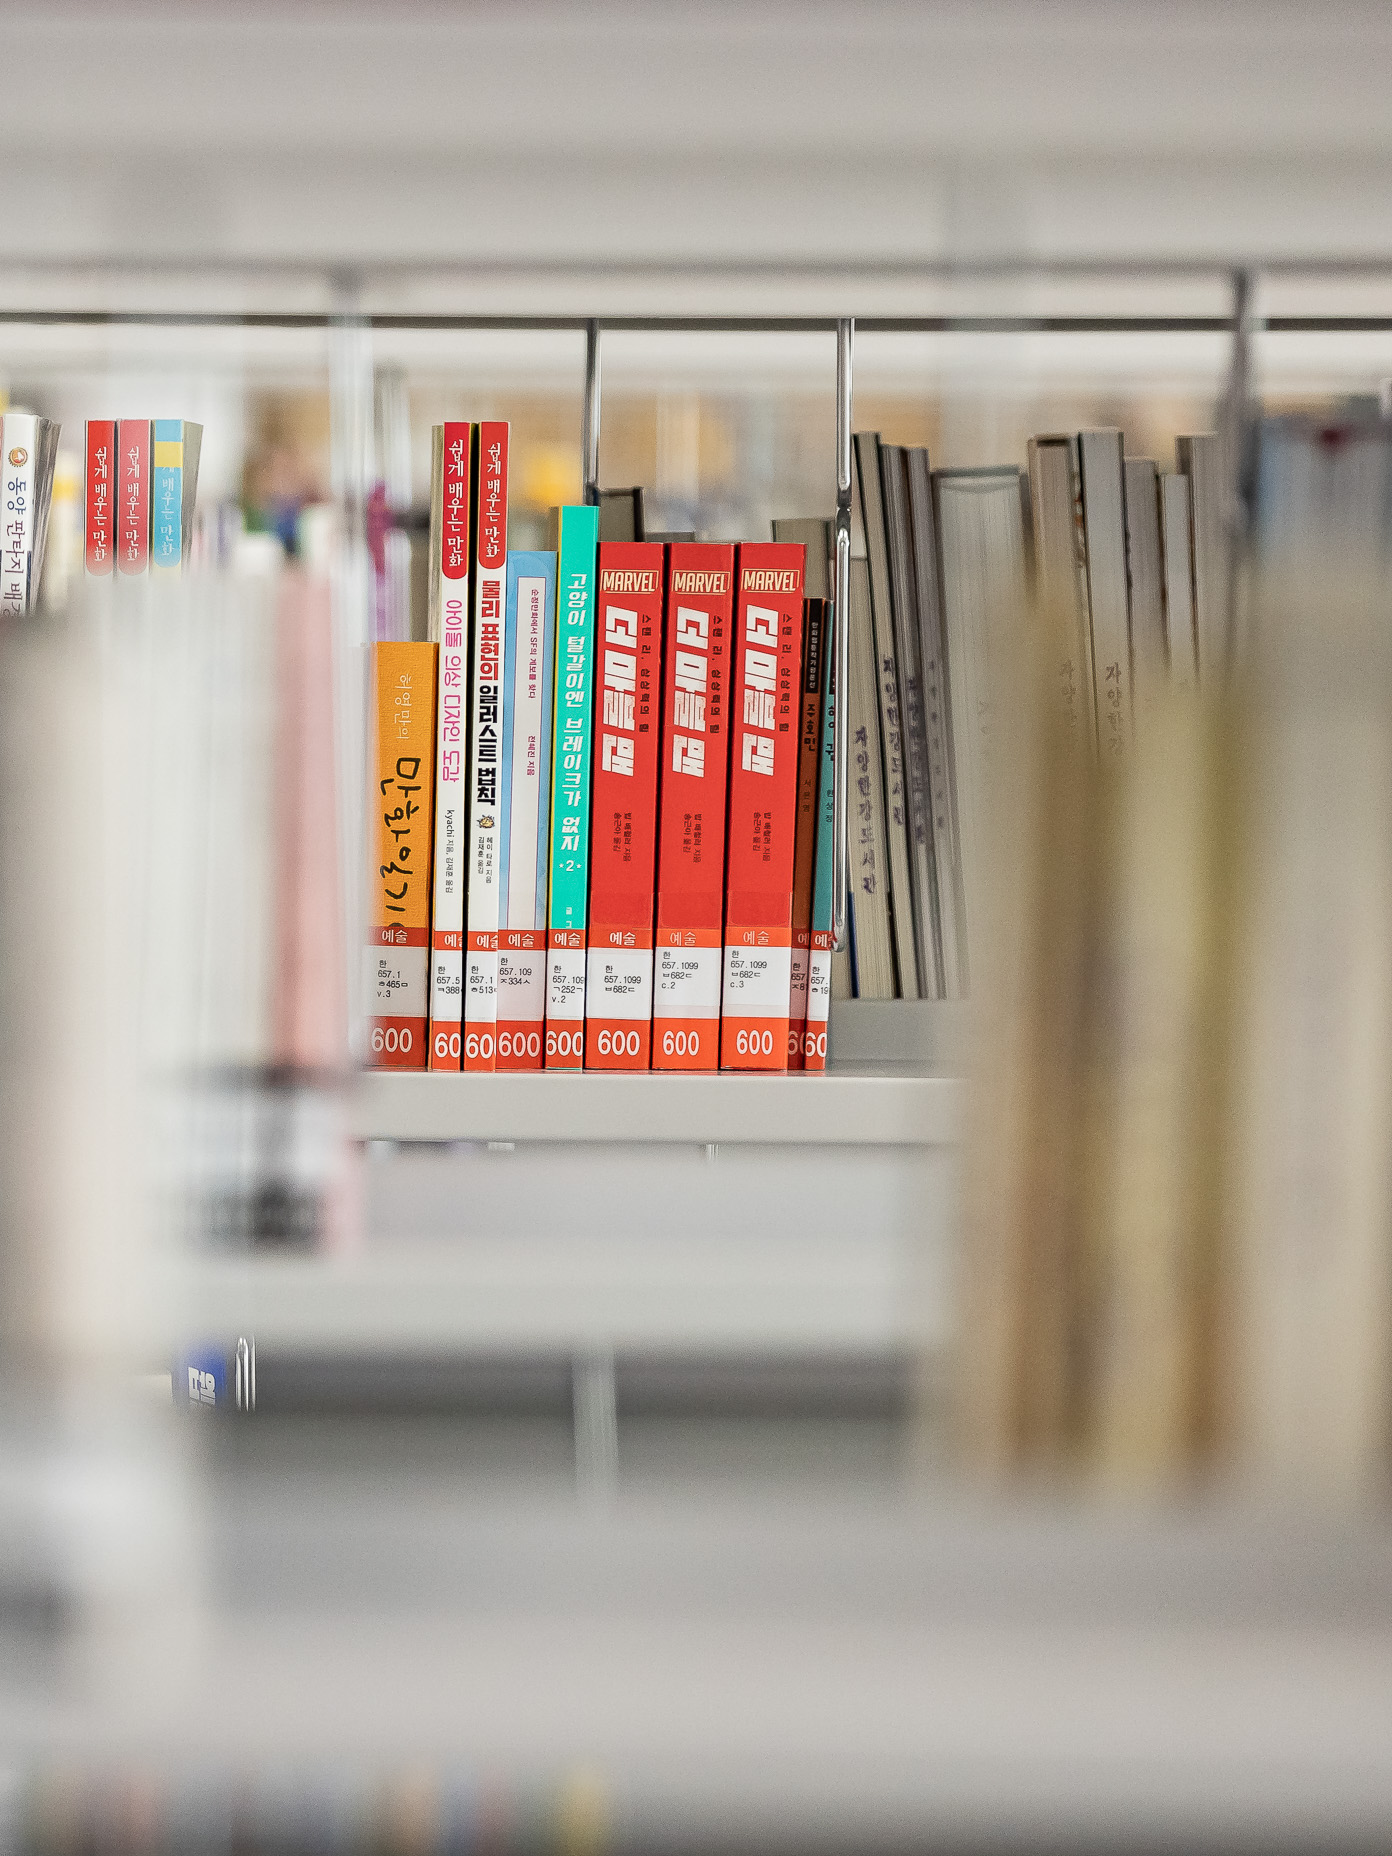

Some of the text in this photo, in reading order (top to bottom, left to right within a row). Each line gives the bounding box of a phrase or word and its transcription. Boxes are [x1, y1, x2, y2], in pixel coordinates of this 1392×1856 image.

[7, 477, 27, 515] 동양
[92, 446, 107, 562] 쉽게 배우는 만화
[125, 446, 140, 561] 쉽게 배우는 만화
[161, 477, 175, 520] 배우는
[447, 439, 464, 567] 쉽게 배우는 만화
[485, 442, 501, 558] 쉽게 배우는 만화
[5, 520, 26, 574] 판타지
[160, 524, 175, 556] 만화
[603, 571, 656, 592] MARVEL
[674, 572, 727, 593] MARVEL
[744, 571, 796, 592] MARVEL
[605, 605, 638, 649] 더
[642, 614, 652, 636] 스탠
[676, 606, 709, 650] 더
[713, 615, 723, 638] 스탠
[745, 604, 779, 648] 더
[782, 613, 792, 636] 스탠
[528, 589, 539, 699] 순정만화에서 SF의 계보를 찾다
[442, 600, 463, 782] 아이돌 의상 디자인 도감
[476, 580, 501, 806] 물리 표현의 일러스트 법칙
[639, 668, 651, 715] 상상력의
[710, 669, 722, 716] 상상력의
[779, 667, 791, 714] 상상력의
[394, 673, 412, 740] 허영만의
[560, 573, 588, 852] 고양이 털갈이엔 브레이크가 없지
[639, 724, 650, 733] 힘
[710, 724, 720, 734] 힘
[779, 723, 789, 732] 힘
[601, 733, 635, 777] 맨
[672, 734, 705, 778] 맨
[741, 732, 775, 776] 맨
[526, 761, 535, 776] 지음
[445, 809, 455, 838] kyachi
[380, 757, 421, 912] 만화일기
[565, 860, 575, 872] 2
[445, 880, 453, 894] 옮김
[381, 929, 408, 943] 예술
[508, 933, 535, 948] 예술
[554, 932, 581, 947] 예술
[609, 931, 636, 946] 예술
[669, 931, 697, 946] 예술
[743, 930, 770, 945] 예술
[379, 960, 387, 968] 한
[500, 957, 509, 966] 한
[662, 951, 671, 960] 한
[730, 960, 767, 969] 657.1099
[731, 950, 739, 959] 한
[377, 970, 401, 979] 657.1
[437, 966, 446, 975] 한
[471, 965, 479, 974] 한
[499, 967, 532, 976] 657.109
[554, 965, 562, 974] 한
[605, 965, 613, 974] 한
[661, 961, 699, 970] 657.1099
[792, 963, 801, 971] 한
[812, 966, 820, 975] 한
[436, 976, 460, 985] 657.5
[470, 975, 493, 985] 657.1
[552, 975, 585, 985] 657.109
[604, 975, 641, 985] 657.1099
[661, 981, 676, 990] c.2
[730, 980, 745, 989] c.3
[377, 990, 391, 998] v.3
[552, 995, 566, 1004] v.2
[371, 1027, 413, 1053] 600
[465, 1033, 497, 1059] 60
[498, 1031, 541, 1057] 600
[546, 1031, 582, 1057] 600
[597, 1029, 640, 1056] 600
[662, 1030, 700, 1056] 600
[736, 1029, 773, 1055] 600
